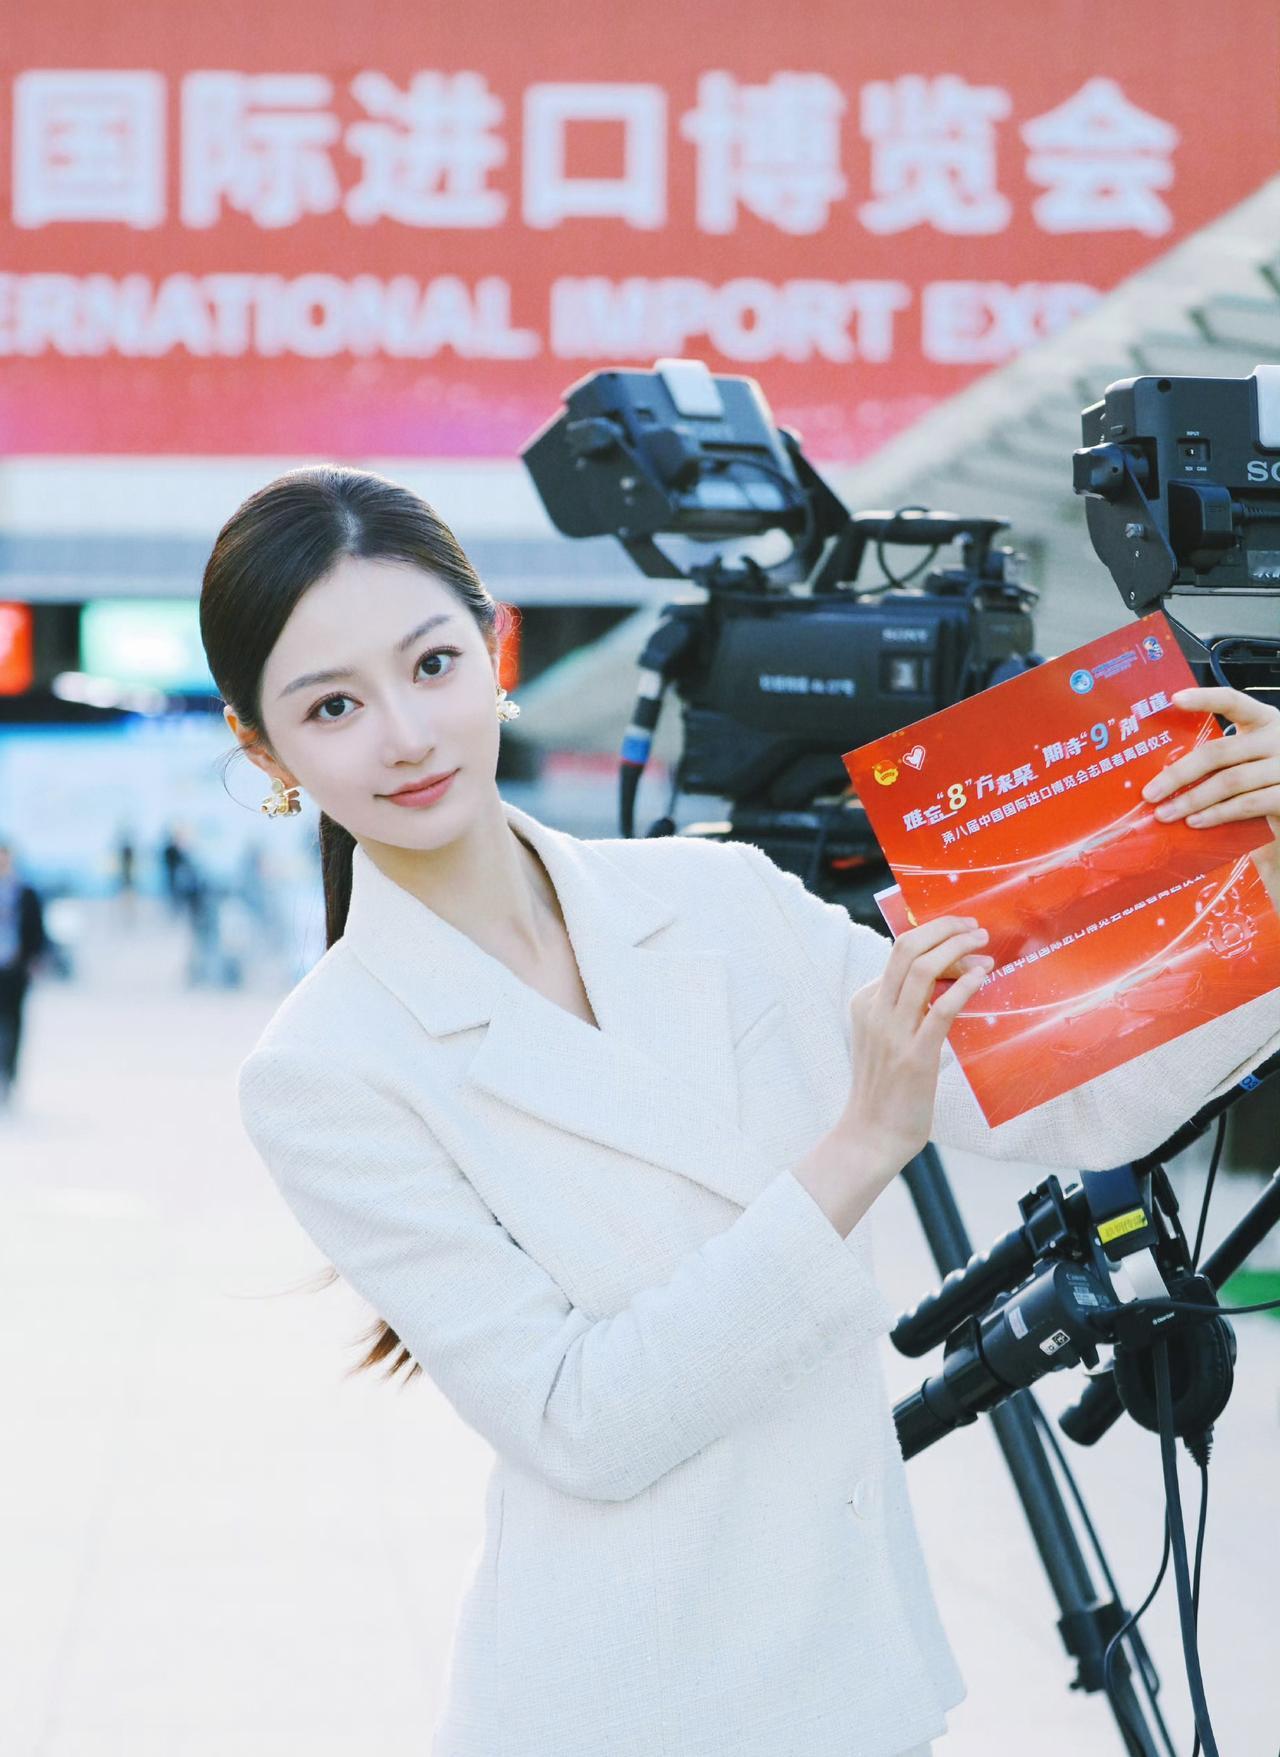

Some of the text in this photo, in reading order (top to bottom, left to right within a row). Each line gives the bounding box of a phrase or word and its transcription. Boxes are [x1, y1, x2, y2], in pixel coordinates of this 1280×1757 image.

[11, 69, 1180, 236] 国际进口博览会
[548, 276, 911, 363] IMPORT
[941, 730, 1173, 845] 第八届中国国际进口博览会志愿者离园仪式
